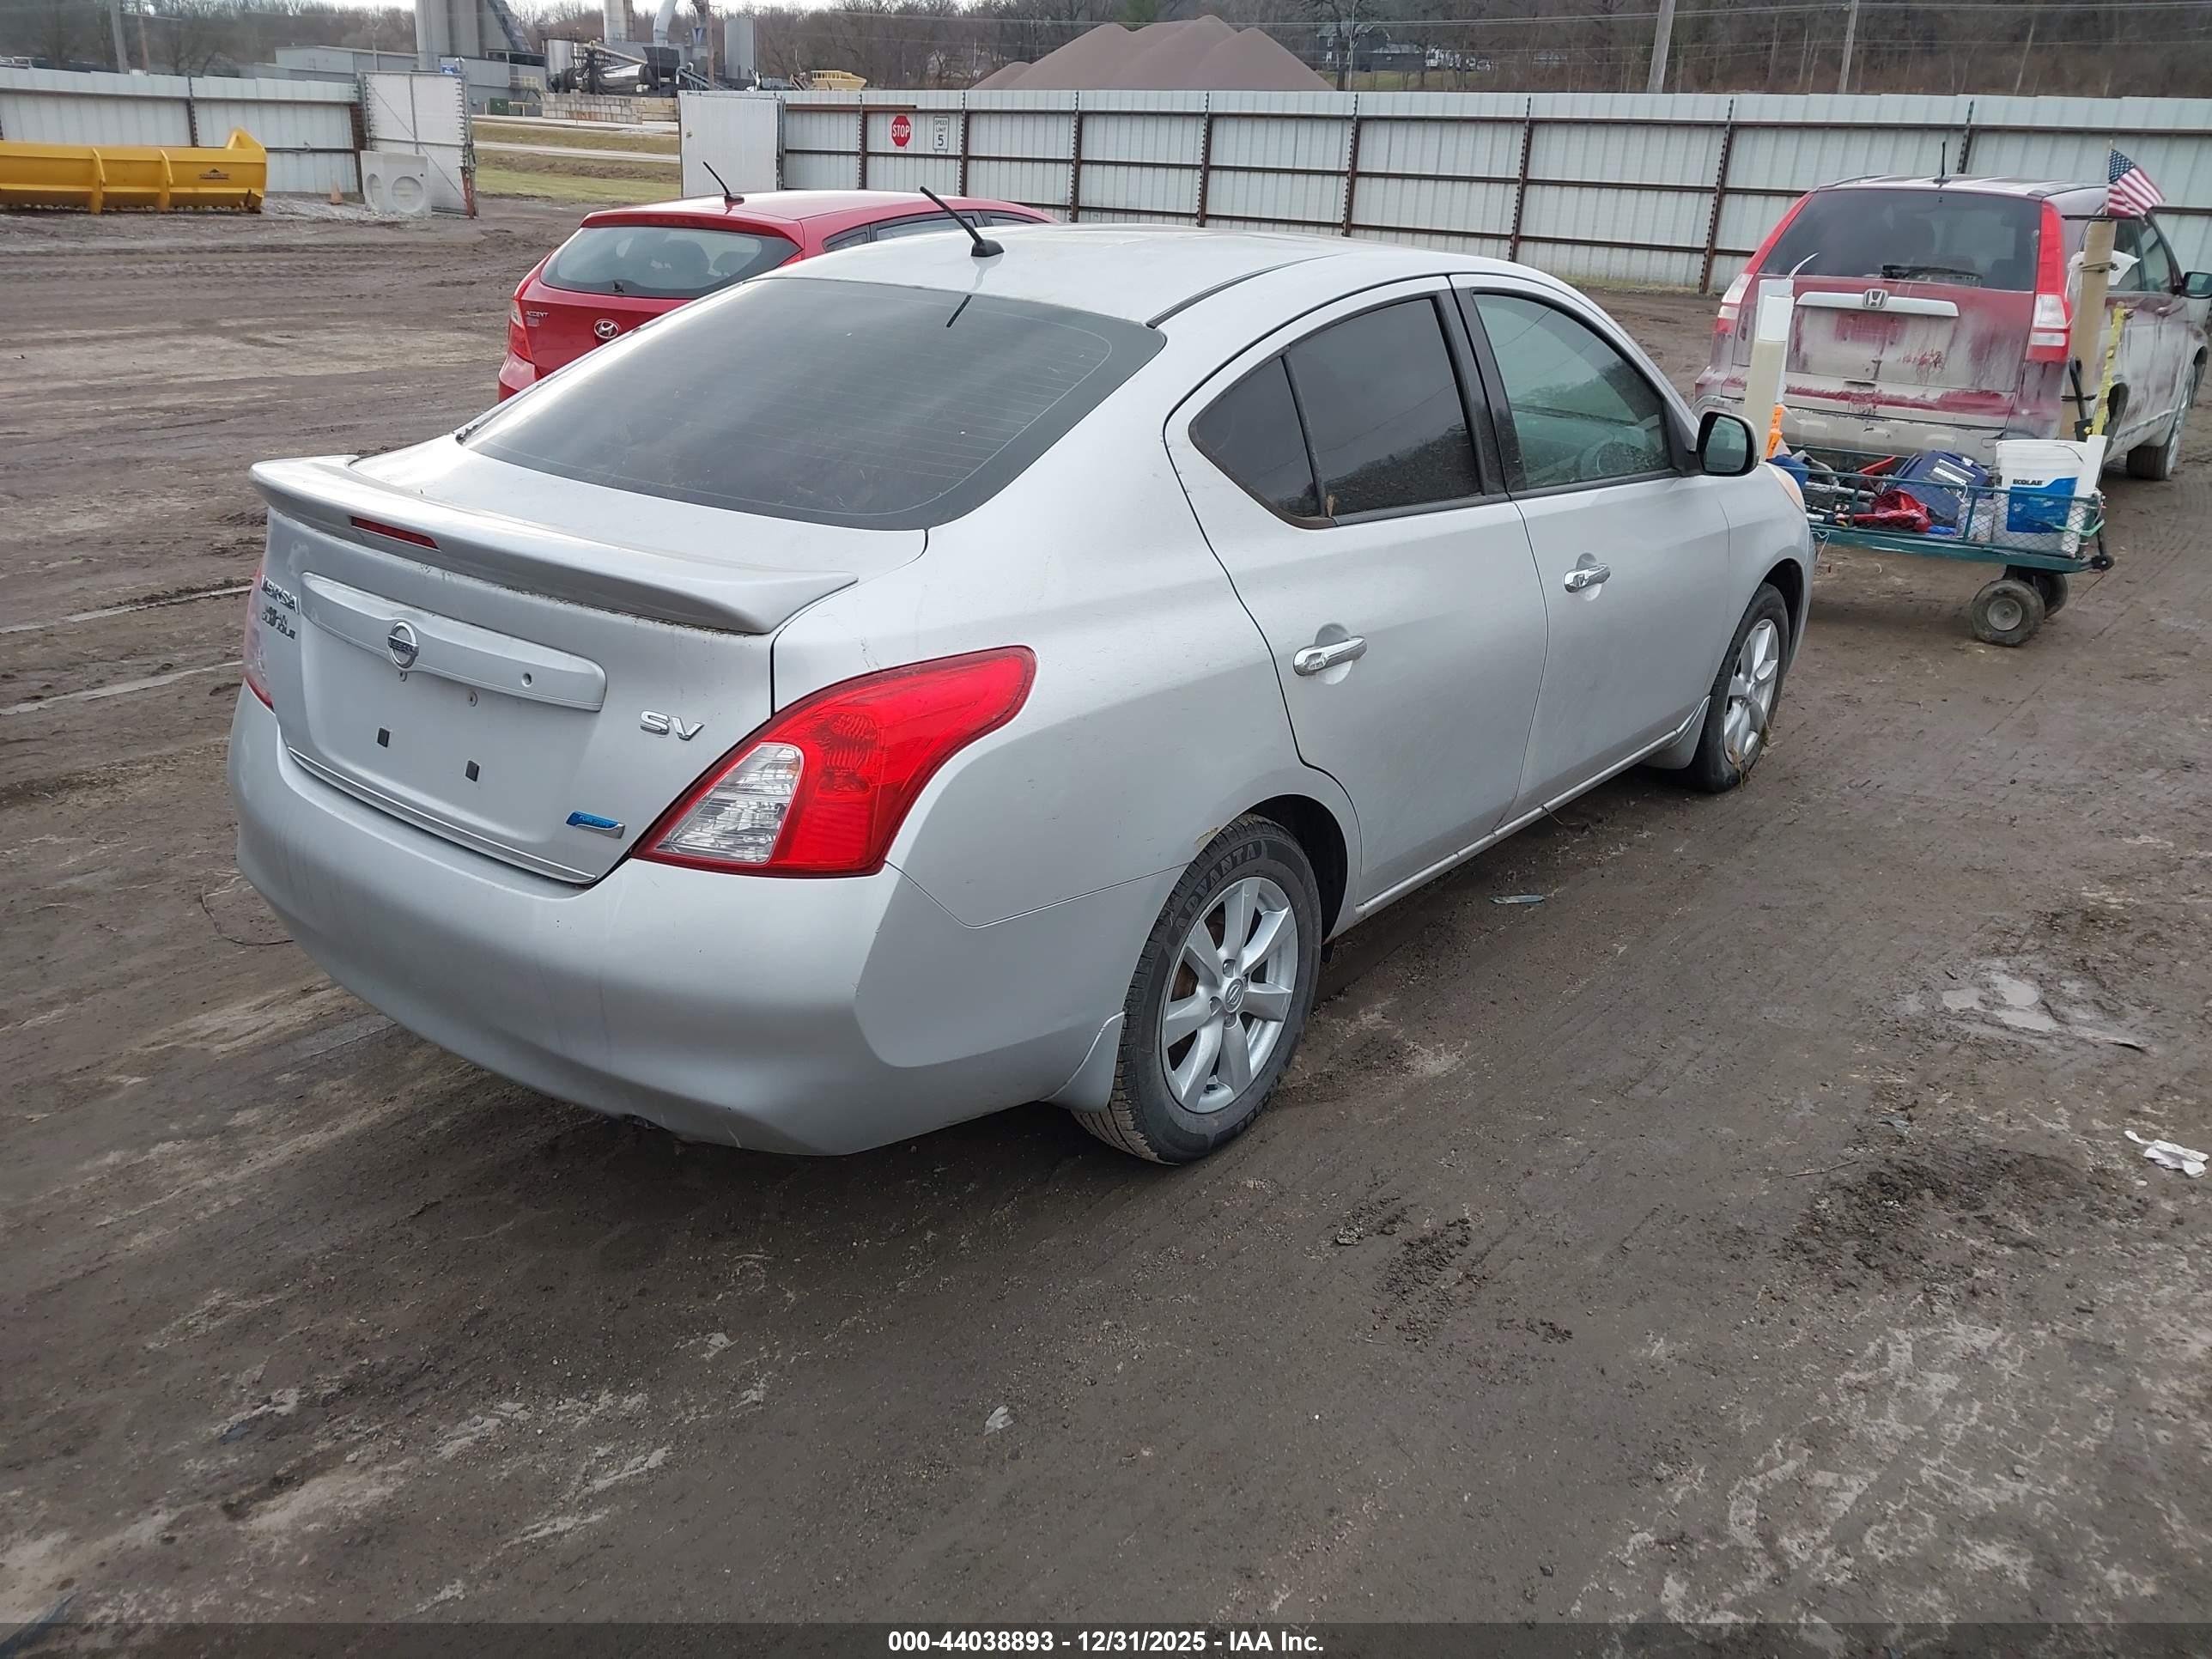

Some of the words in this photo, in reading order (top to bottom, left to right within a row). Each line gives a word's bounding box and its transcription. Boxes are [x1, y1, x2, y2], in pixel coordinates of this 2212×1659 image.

[892, 125, 910, 138] STOP
[938, 134, 945, 146] 5
[261, 574, 301, 614] VERSA
[640, 710, 705, 741] SV
